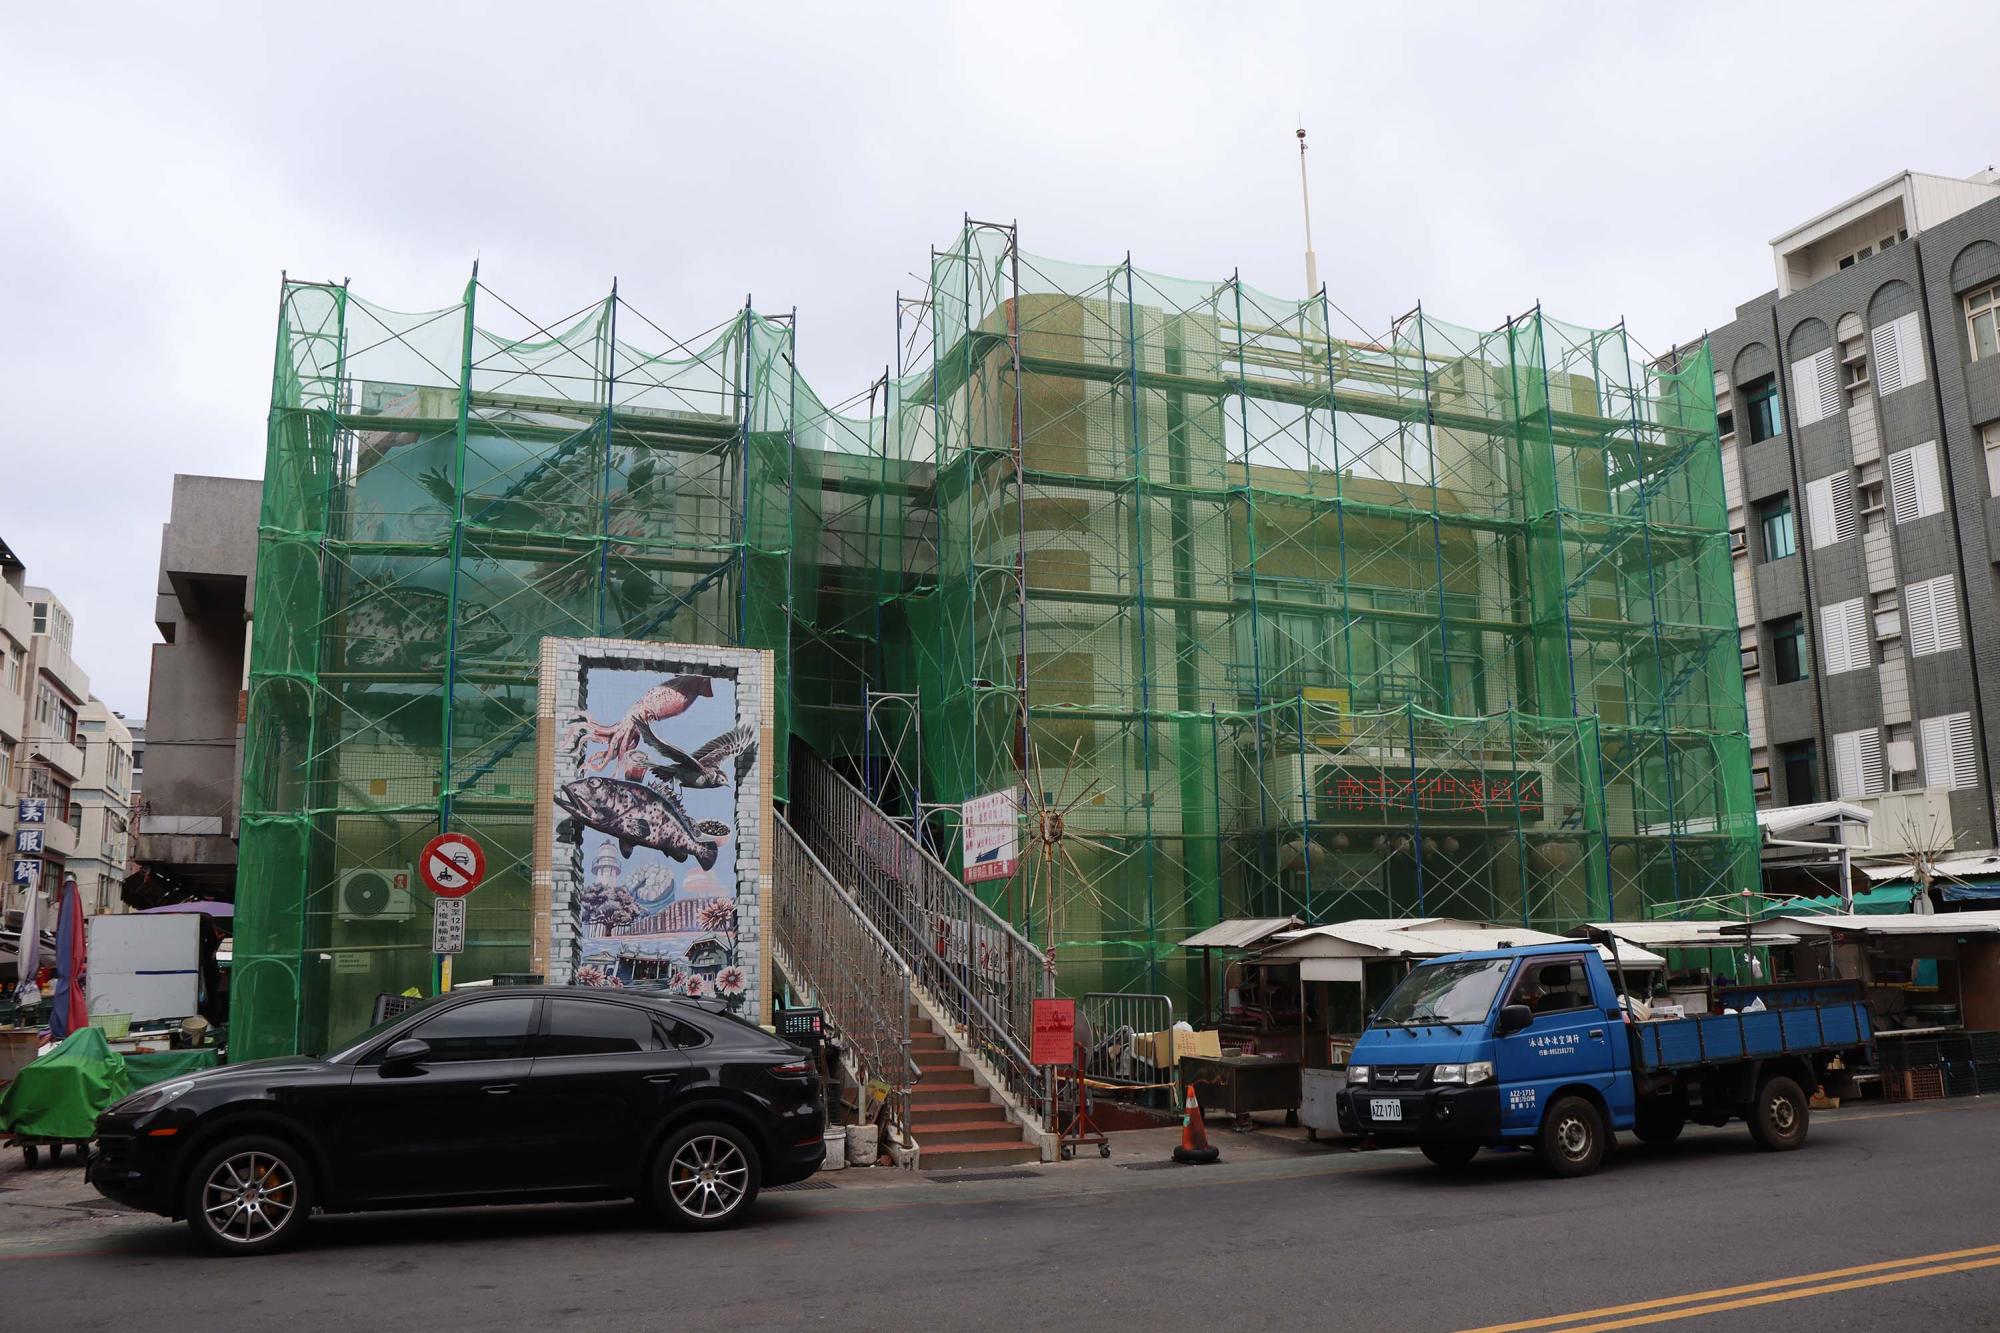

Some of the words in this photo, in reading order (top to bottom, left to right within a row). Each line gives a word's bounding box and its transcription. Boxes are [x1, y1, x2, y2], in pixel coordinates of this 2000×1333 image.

[1325, 775, 1541, 812] 南市西門淺草公
